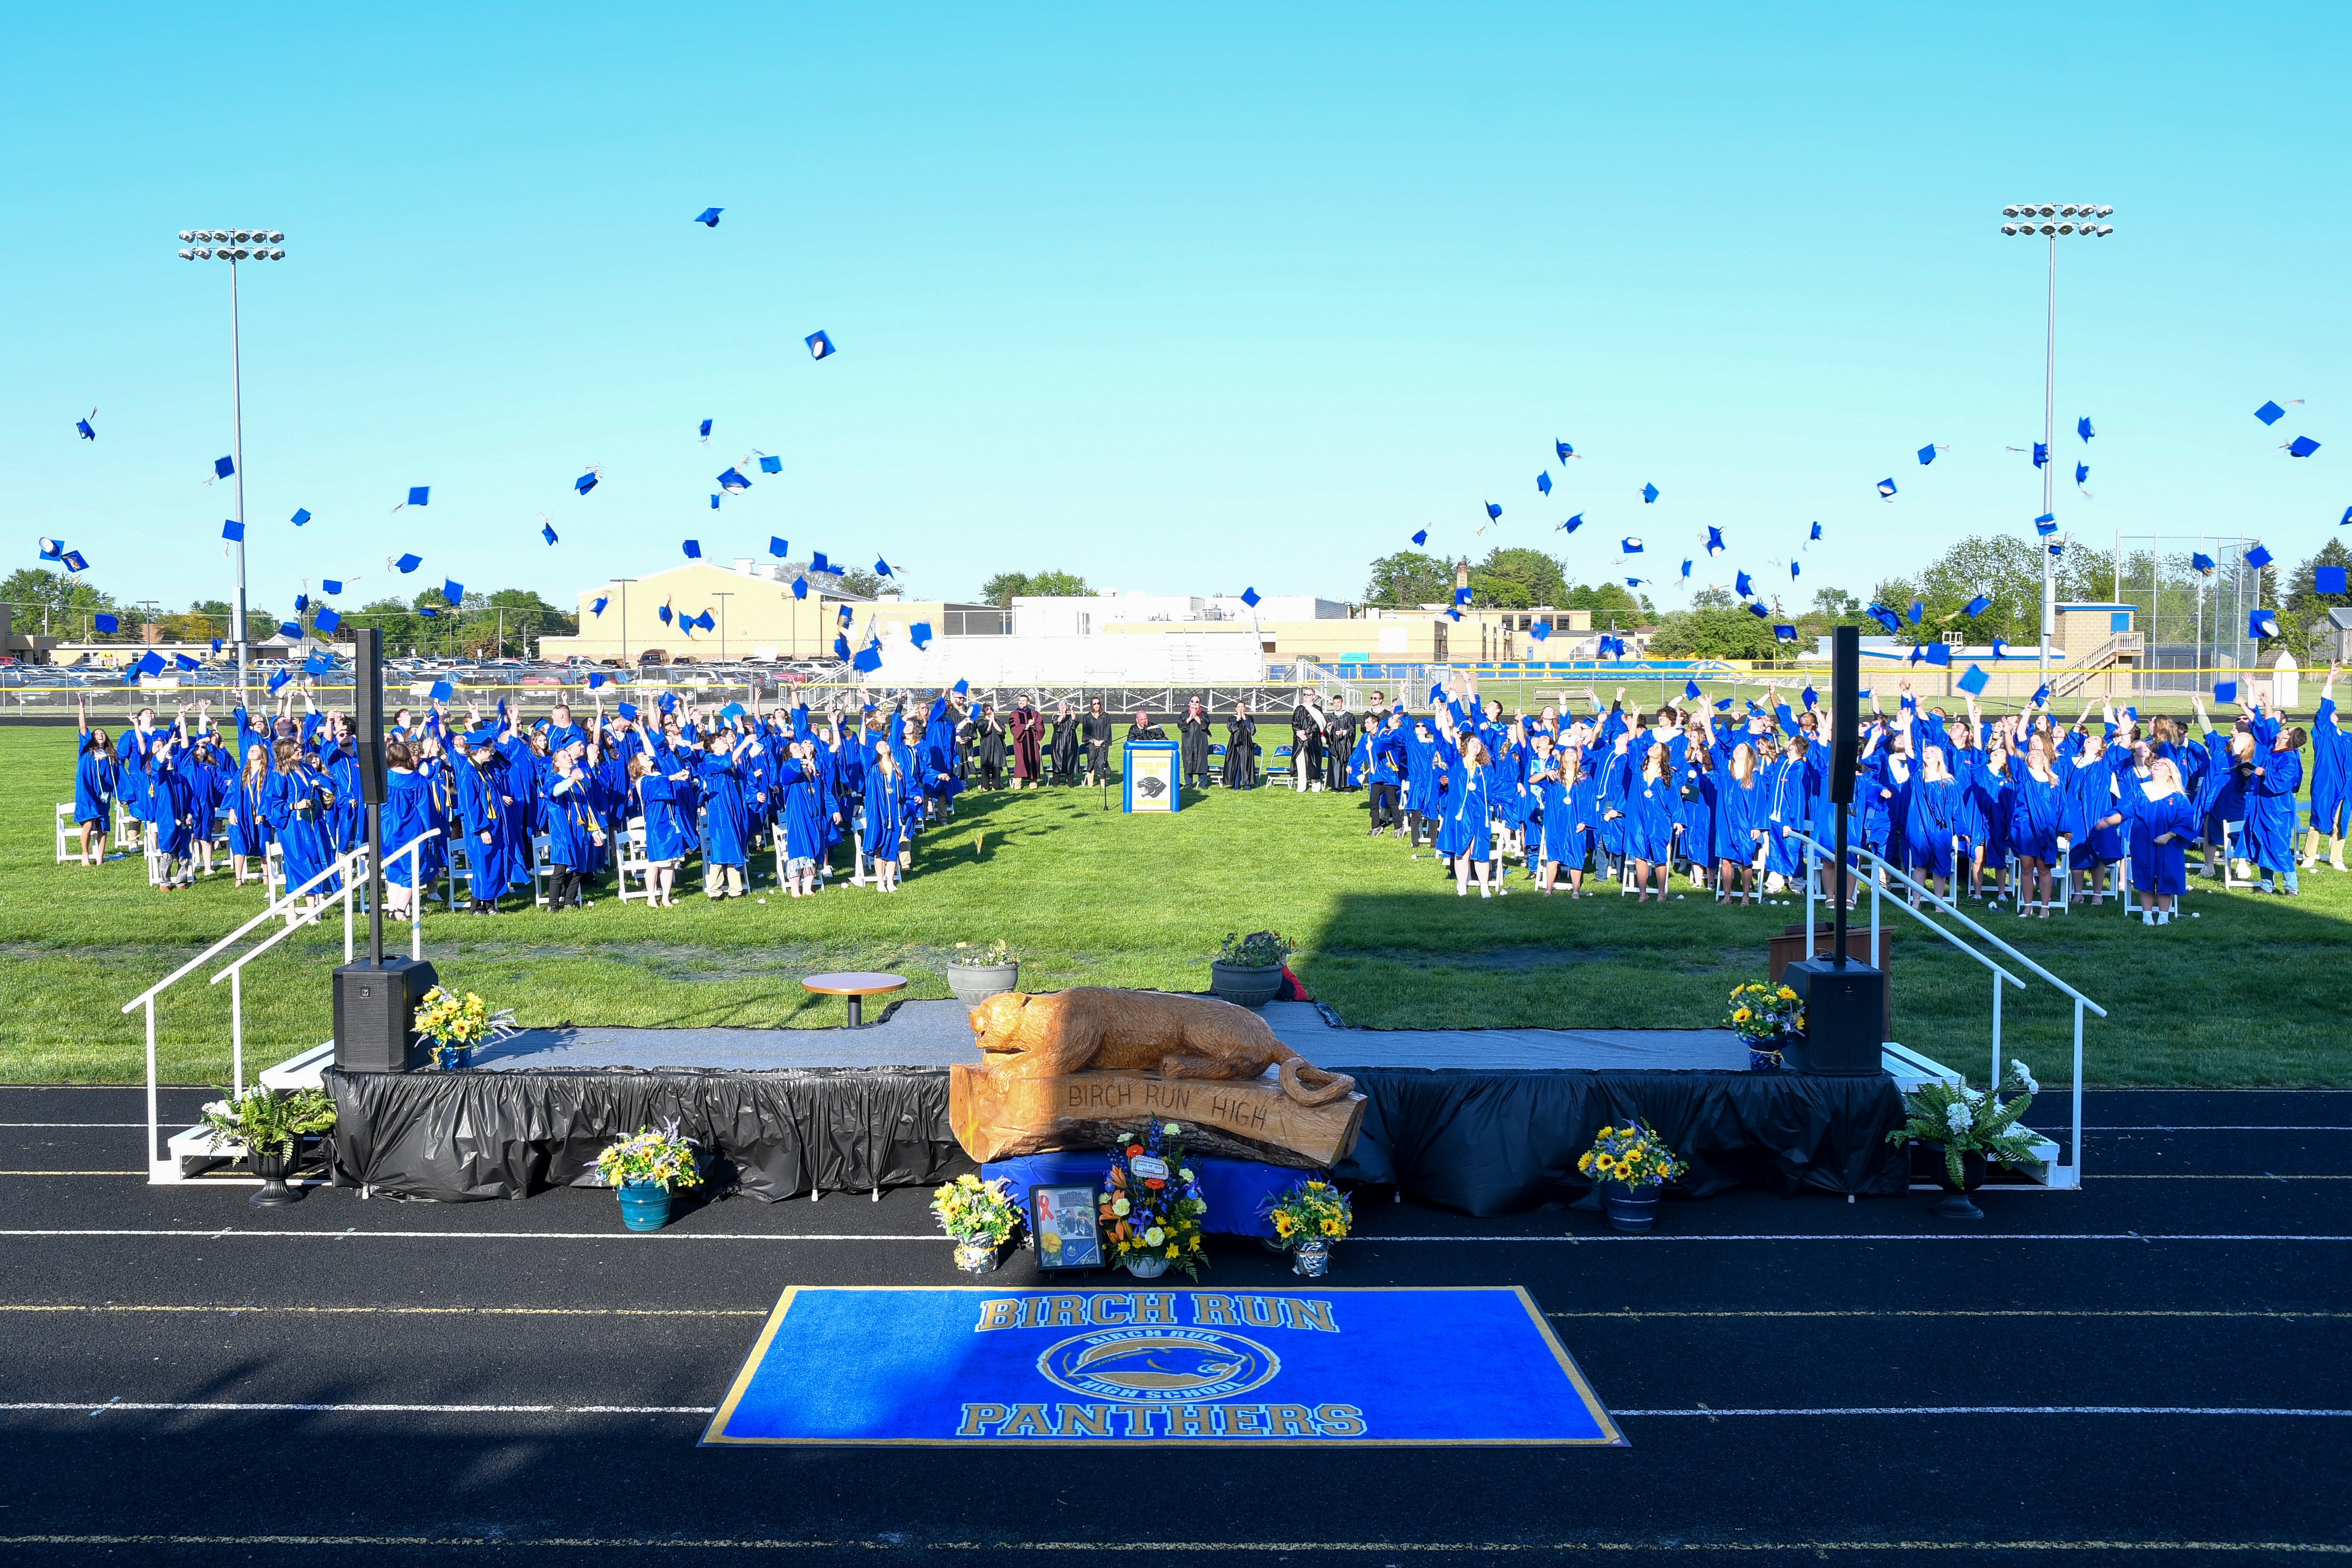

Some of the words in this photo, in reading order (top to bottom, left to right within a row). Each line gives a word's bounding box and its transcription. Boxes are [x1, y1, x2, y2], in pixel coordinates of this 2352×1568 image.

[1069, 1084, 1131, 1107] BIRCH
[1146, 1084, 1190, 1111] RUN
[1211, 1095, 1267, 1131] HIGH
[975, 1293, 1176, 1332] BIRCH
[1193, 1293, 1340, 1333] RUN
[1084, 1329, 1164, 1344] BIRCH
[1169, 1330, 1223, 1343] RUN
[1076, 1379, 1142, 1398] HIGH
[1144, 1380, 1245, 1399] SCHOOL
[957, 1403, 1368, 1436] PANTHERS
